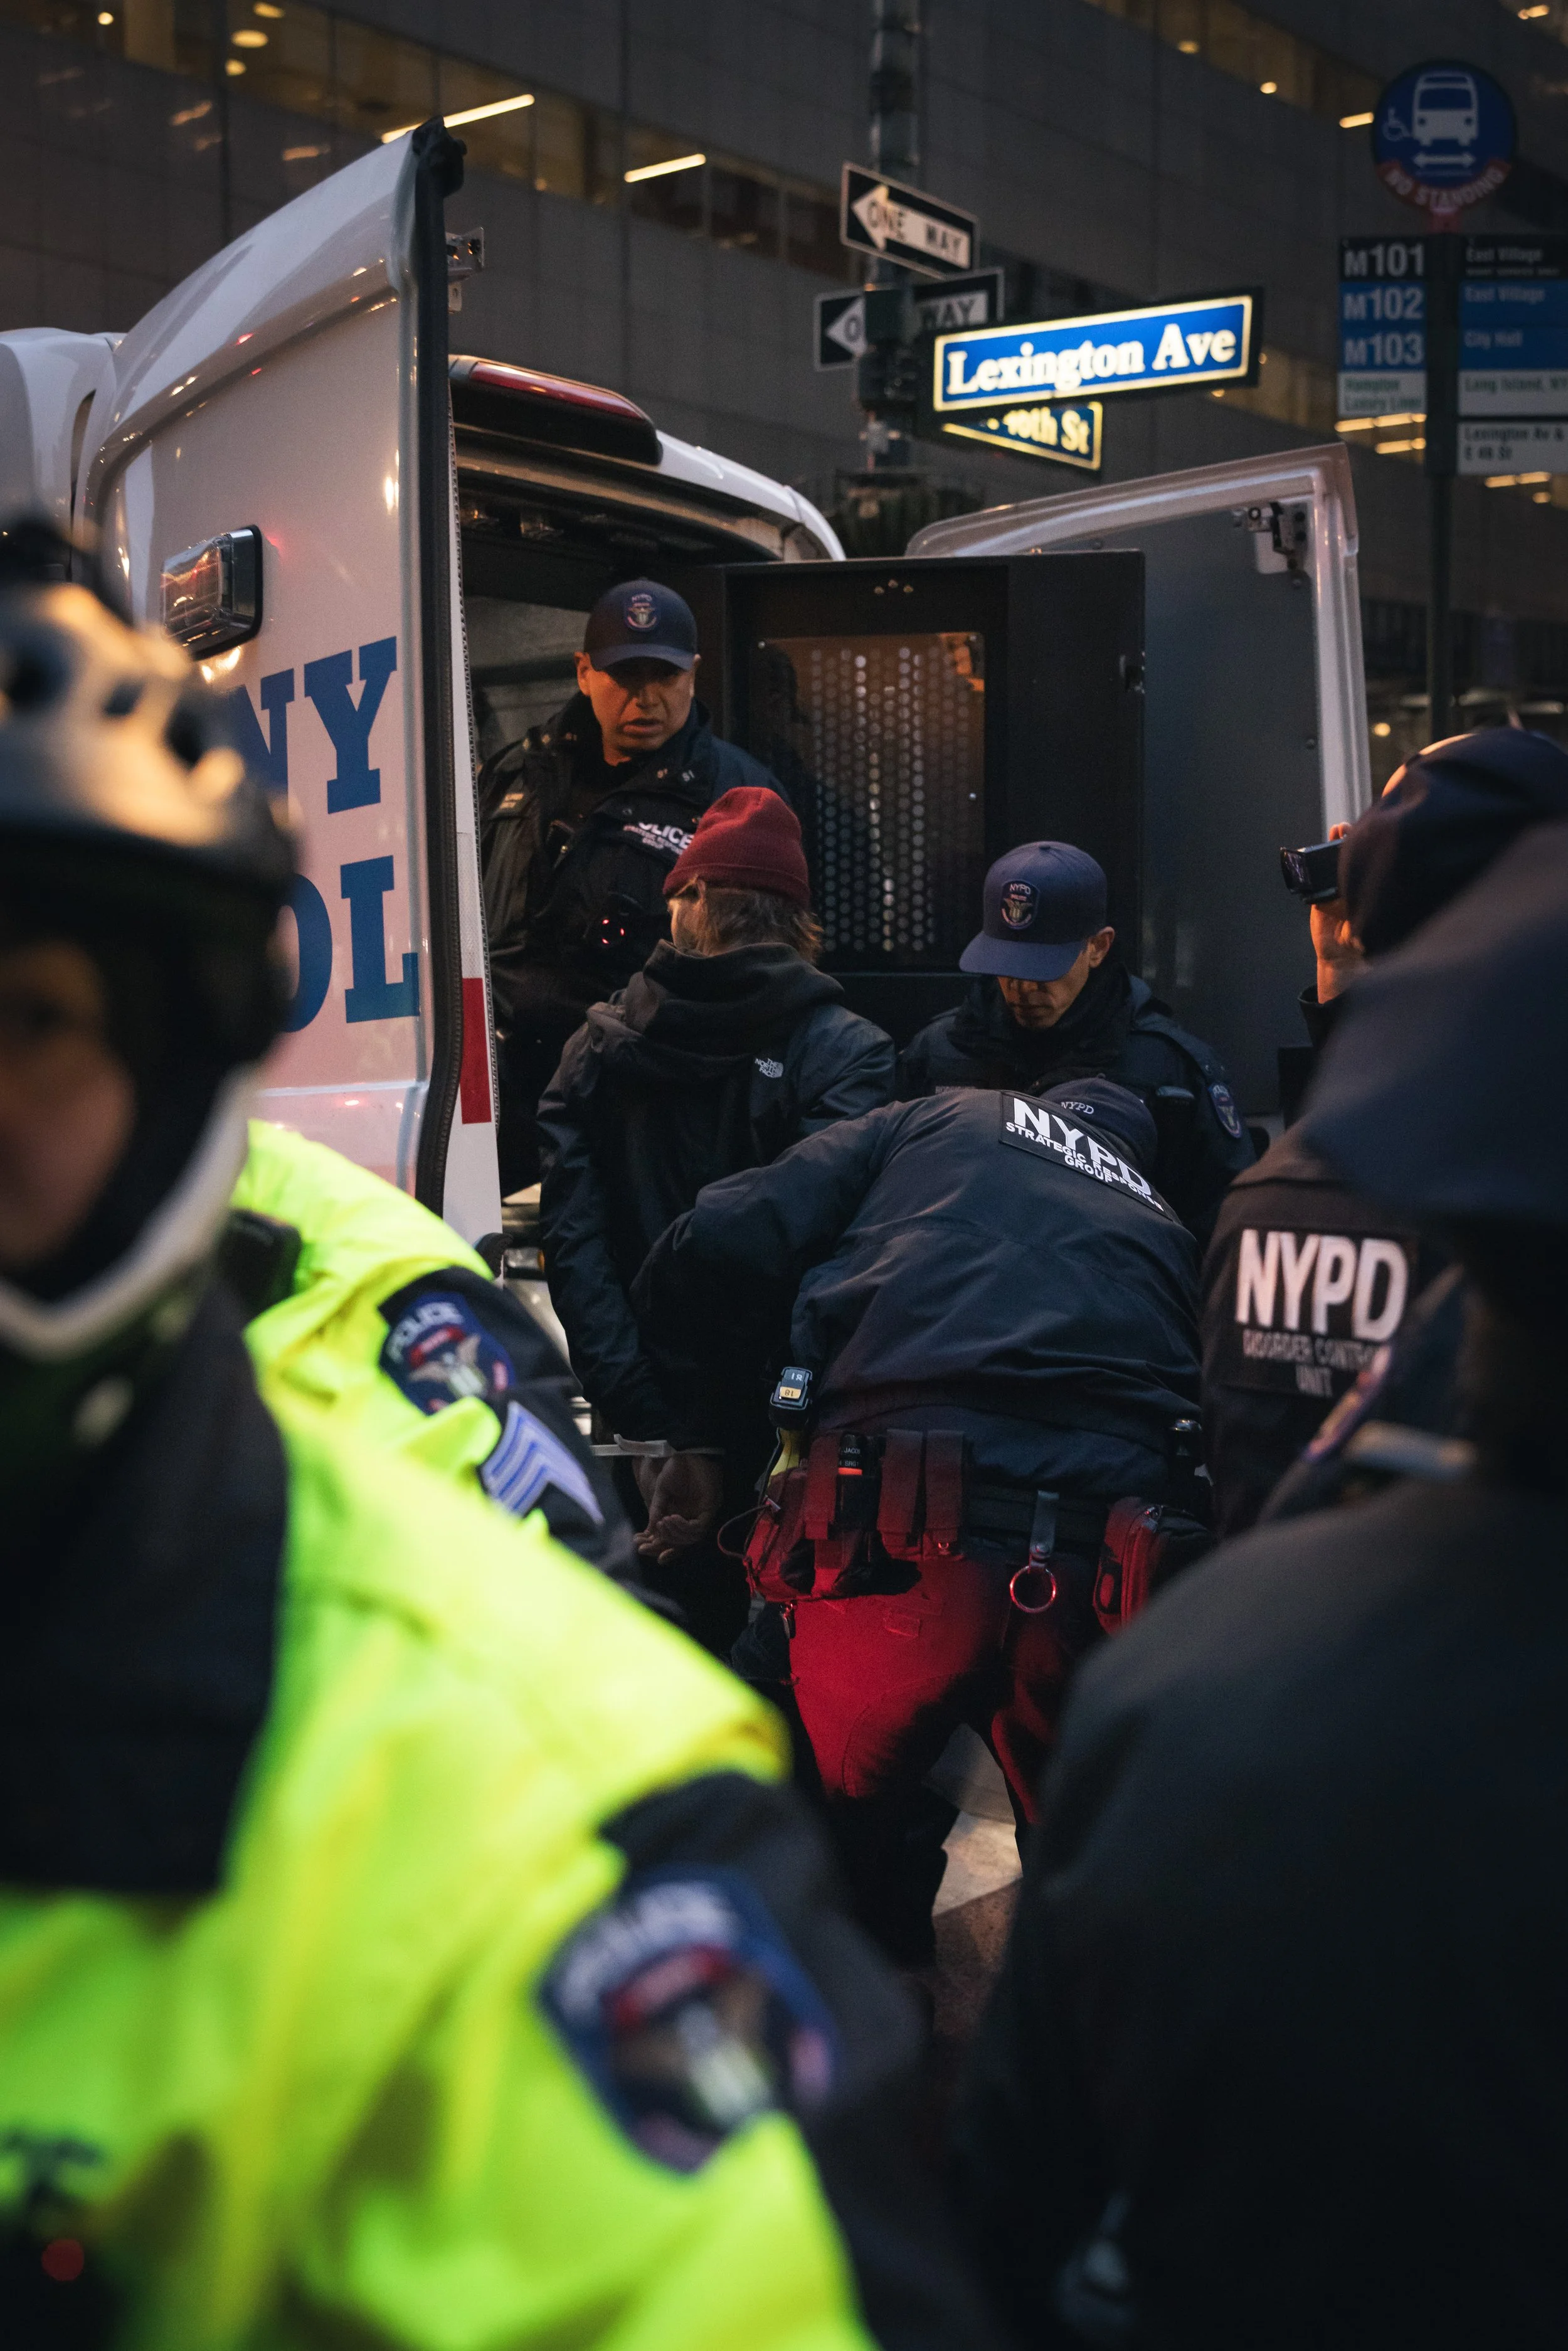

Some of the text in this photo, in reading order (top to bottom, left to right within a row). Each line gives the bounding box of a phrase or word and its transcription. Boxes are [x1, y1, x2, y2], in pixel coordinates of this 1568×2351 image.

[1384, 168, 1414, 196] NO
[866, 199, 964, 258] ONE WAY
[1344, 242, 1425, 278] M101
[1343, 286, 1424, 321] M102
[946, 323, 1236, 395] Lexington Ave
[1344, 331, 1425, 366] M103
[1061, 409, 1091, 455] St
[638, 821, 694, 849] OLICE
[1009, 883, 1032, 895] NYPD
[278, 855, 419, 1033] OL
[1061, 1100, 1095, 1115] NYPD
[1005, 1121, 1087, 1164] STRATEGIC
[1013, 1097, 1152, 1197] NYPD
[1064, 1153, 1113, 1184] GROUP
[1234, 1228, 1409, 1342] NYPD
